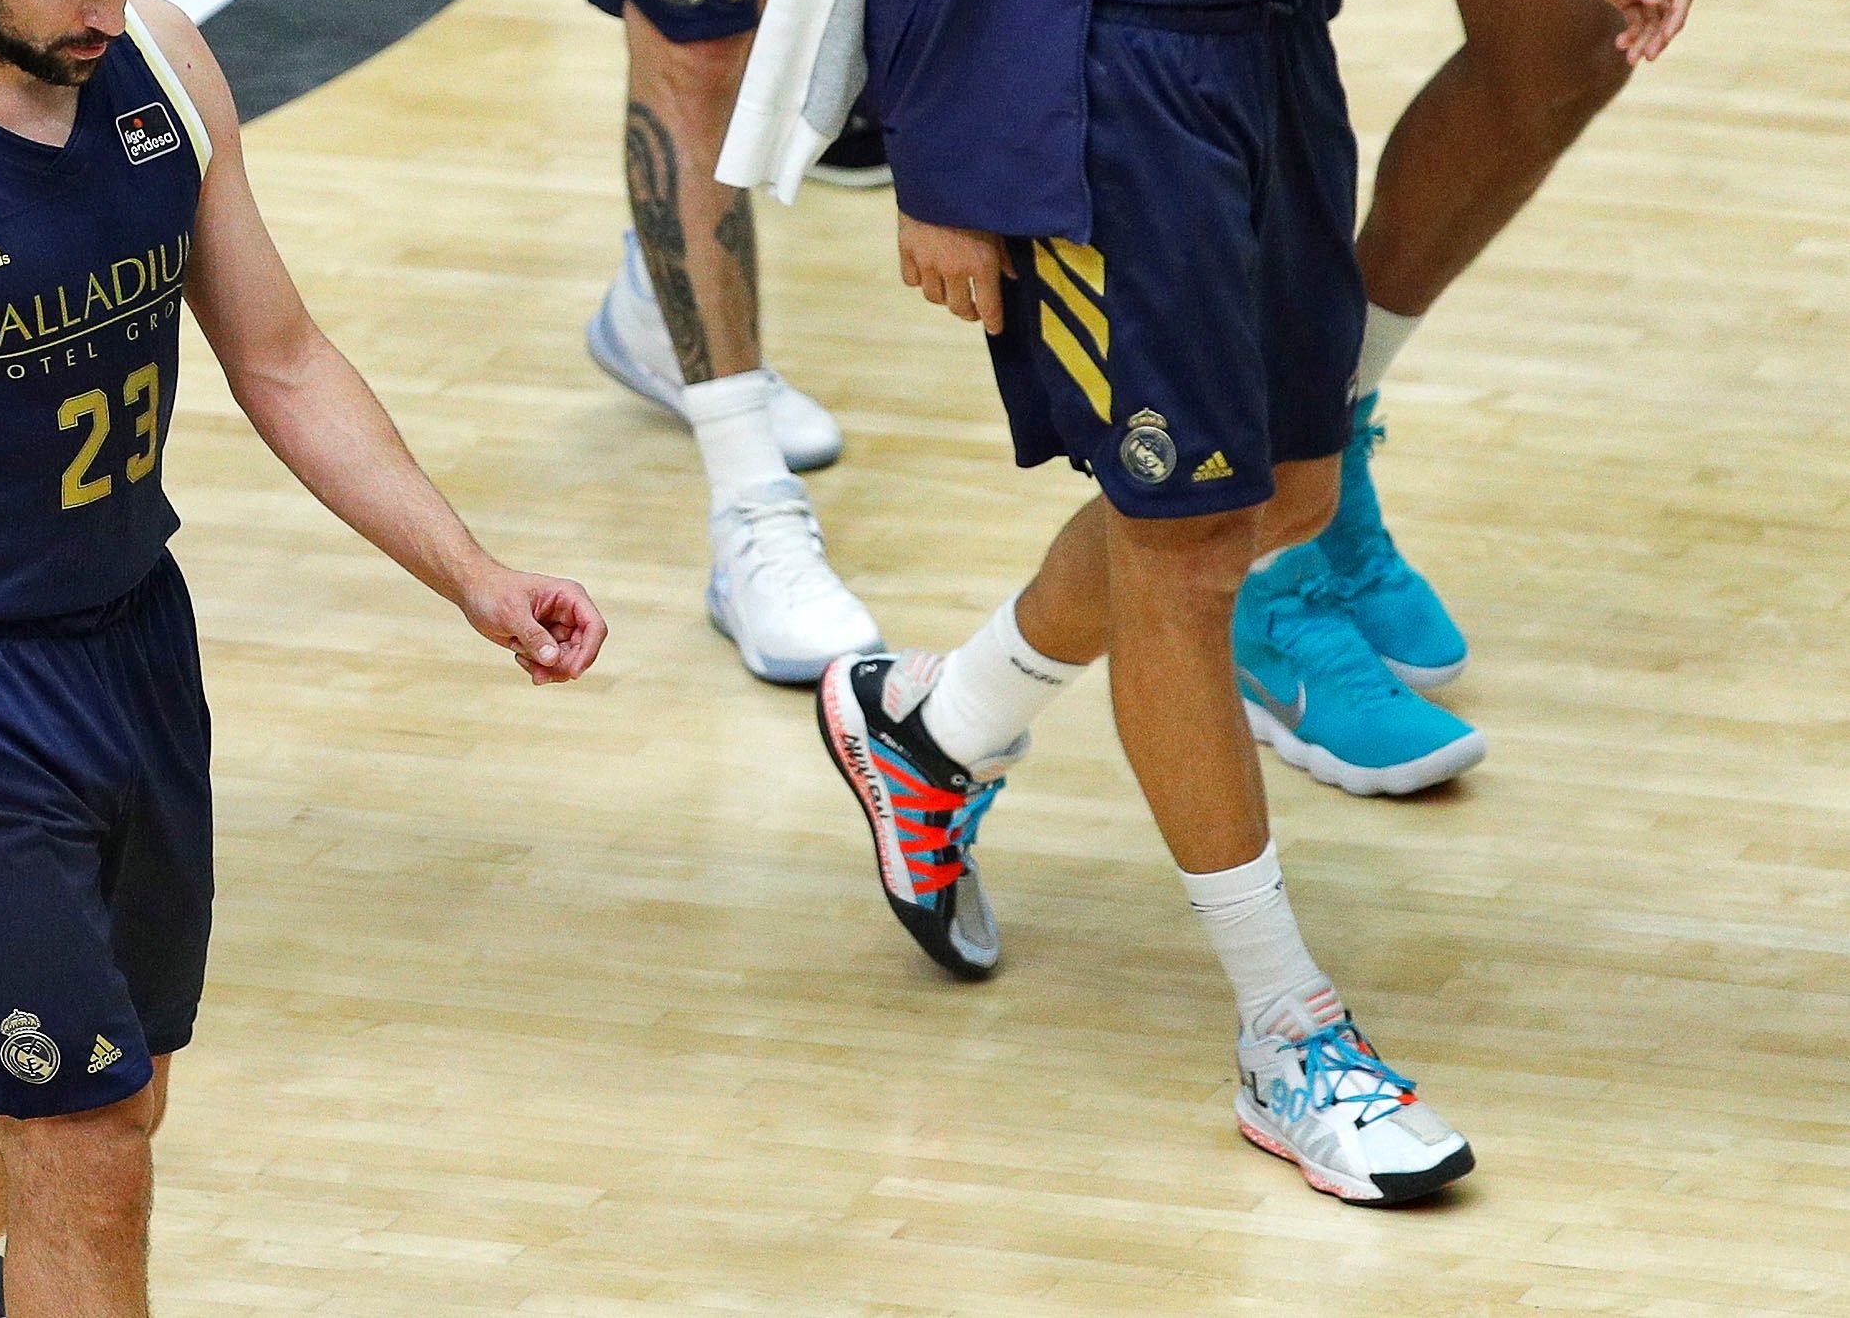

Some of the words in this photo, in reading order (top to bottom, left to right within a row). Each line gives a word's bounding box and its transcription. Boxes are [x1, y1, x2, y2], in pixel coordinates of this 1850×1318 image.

[124, 128, 146, 144] liga
[130, 132, 174, 157] endesa
[126, 300, 176, 341] GRO
[57, 361, 160, 510] 23
[86, 1046, 123, 1075] adidas
